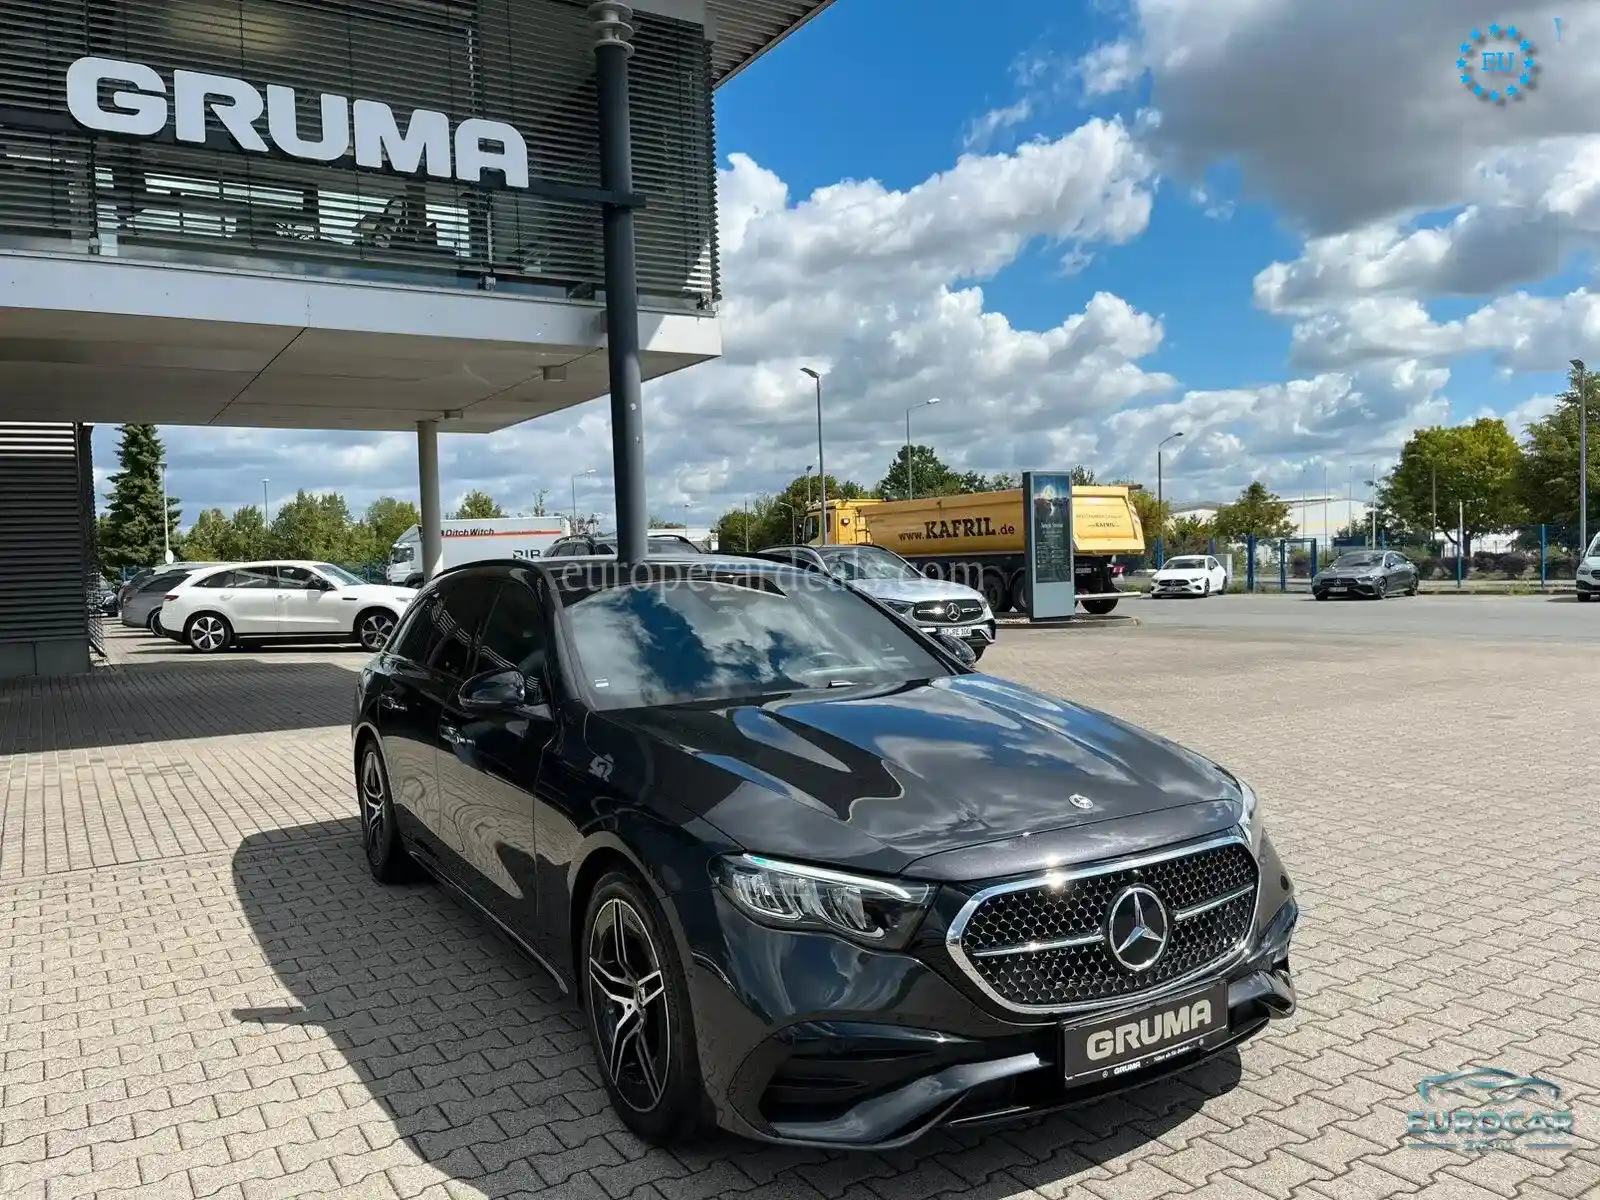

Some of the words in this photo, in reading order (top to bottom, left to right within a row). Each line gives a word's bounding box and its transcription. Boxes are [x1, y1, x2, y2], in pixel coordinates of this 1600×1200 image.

[66, 57, 529, 188] GRUMA
[446, 529, 469, 537] Ditch
[470, 528, 494, 536] Witch
[898, 517, 1015, 541] www.KAFRIL.de
[1086, 999, 1212, 1061] GRUMA
[1113, 1061, 1141, 1075] GRUMA
